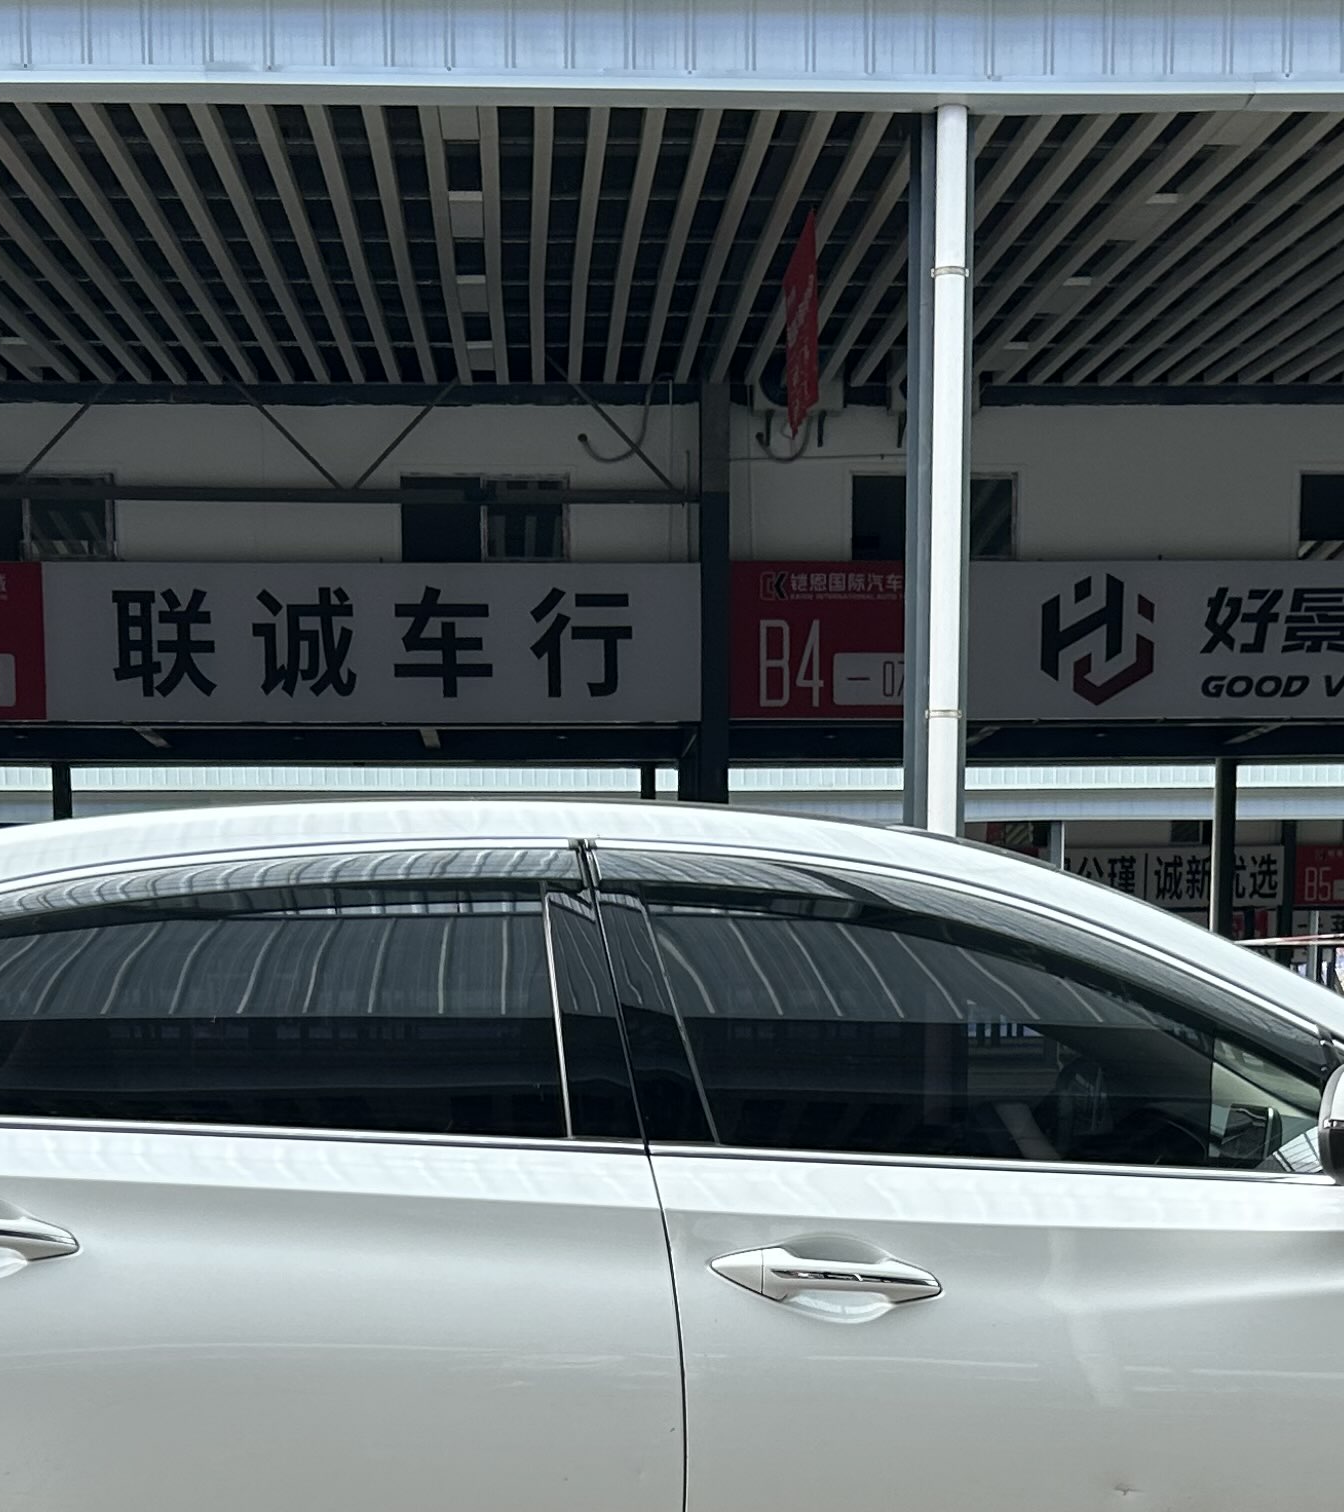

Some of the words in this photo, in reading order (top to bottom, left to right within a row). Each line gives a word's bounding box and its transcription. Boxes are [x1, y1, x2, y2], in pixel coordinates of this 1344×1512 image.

[111, 587, 632, 698] 联诚车行
[1201, 674, 1311, 698] GOOD
